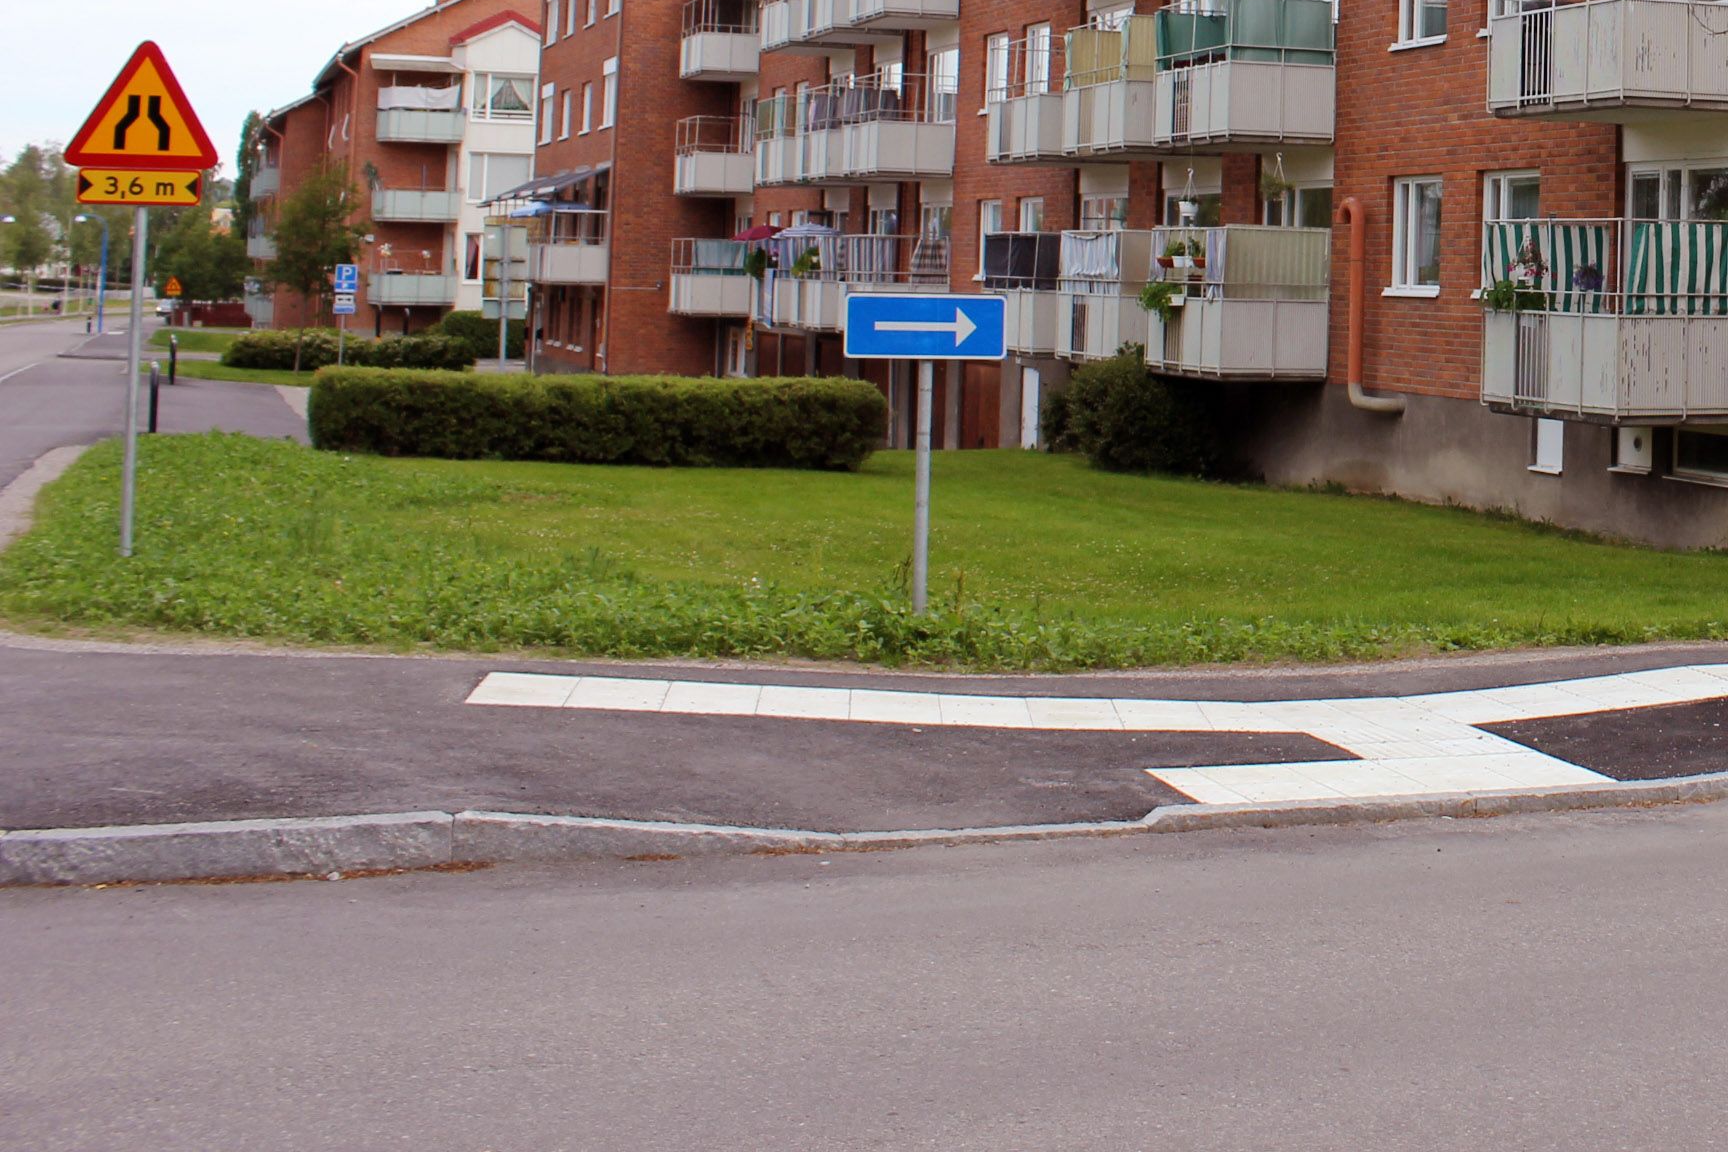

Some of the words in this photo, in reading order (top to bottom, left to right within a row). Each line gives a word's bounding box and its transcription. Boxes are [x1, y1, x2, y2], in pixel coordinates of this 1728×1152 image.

[104, 176, 144, 199] 3,6
[155, 181, 175, 196] m
[342, 266, 352, 279] P
